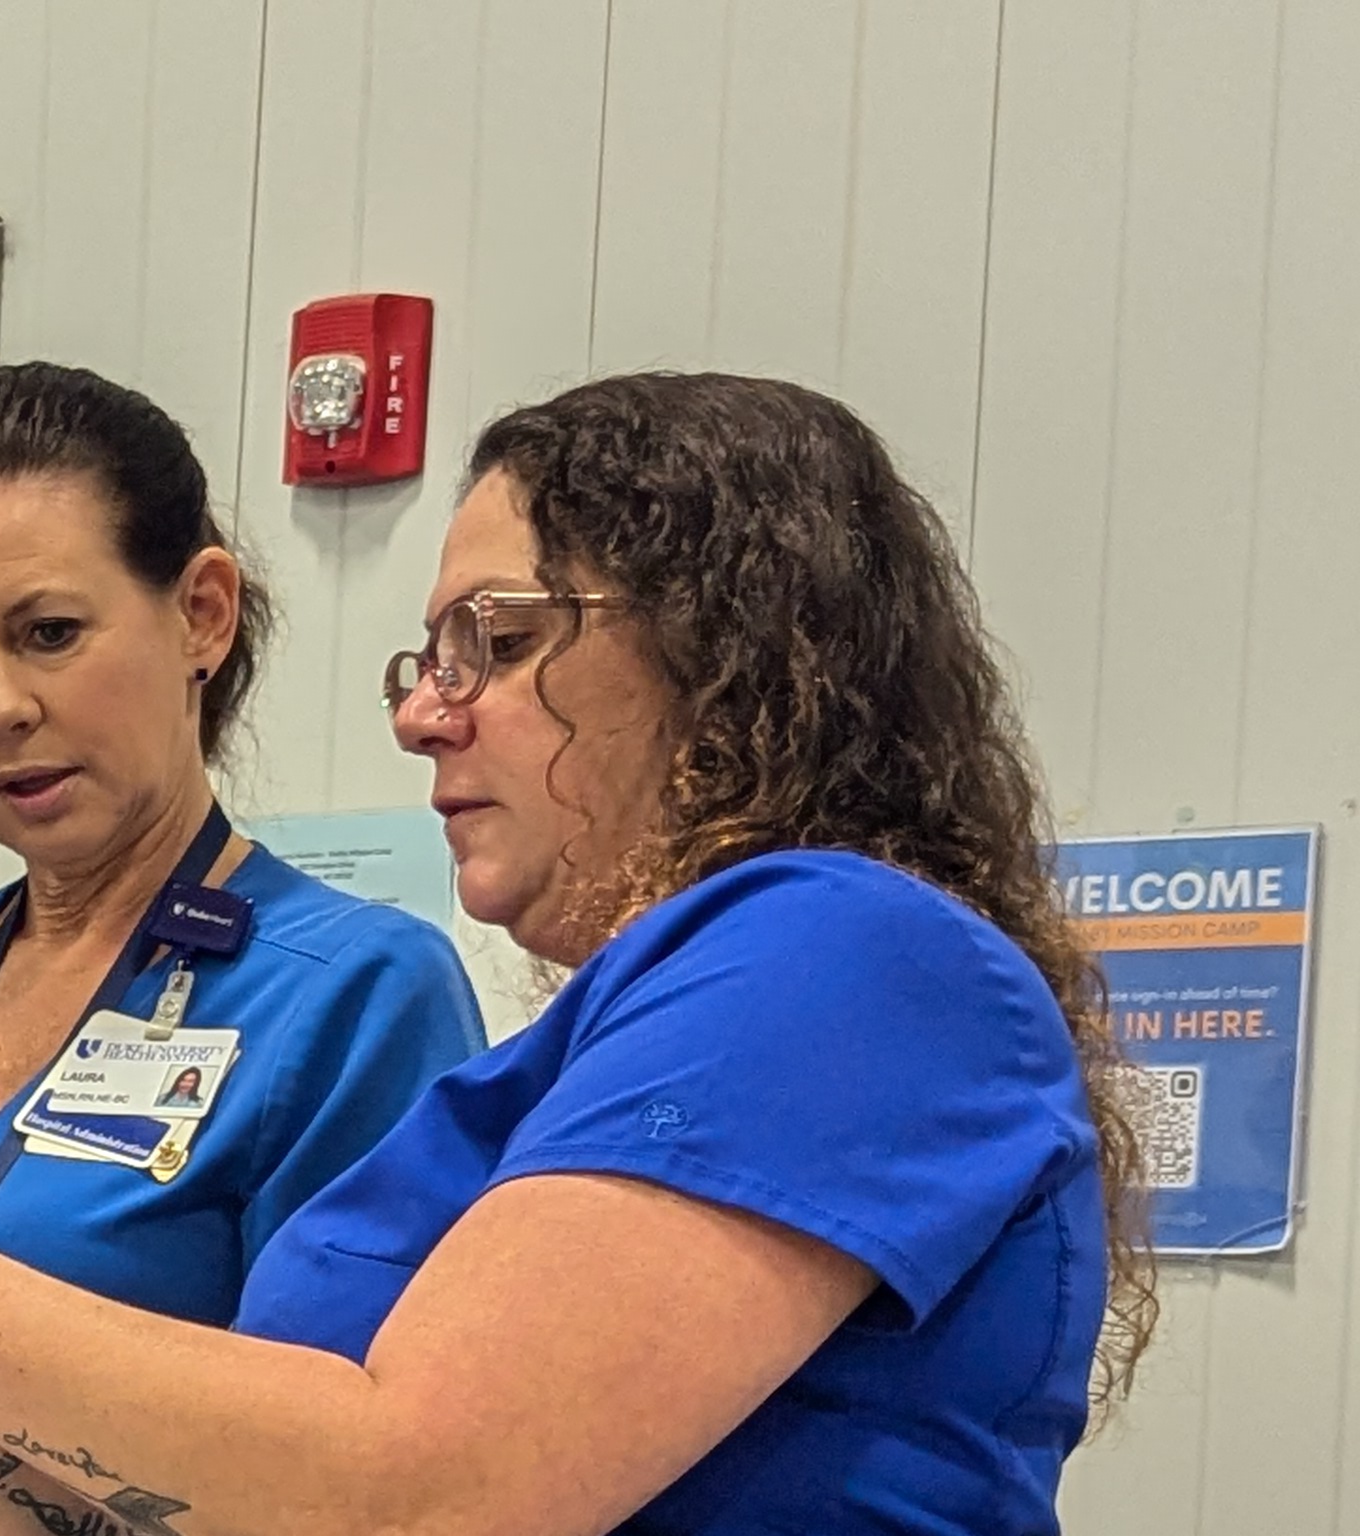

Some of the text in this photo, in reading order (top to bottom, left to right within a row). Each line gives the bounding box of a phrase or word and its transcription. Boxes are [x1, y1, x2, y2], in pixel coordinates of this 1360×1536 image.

[385, 354, 404, 435] FIRE
[1118, 924, 1197, 941] MISSION
[1202, 920, 1262, 938] CAMP
[1125, 1011, 1161, 1040] IN
[60, 1070, 106, 1083] LAURA
